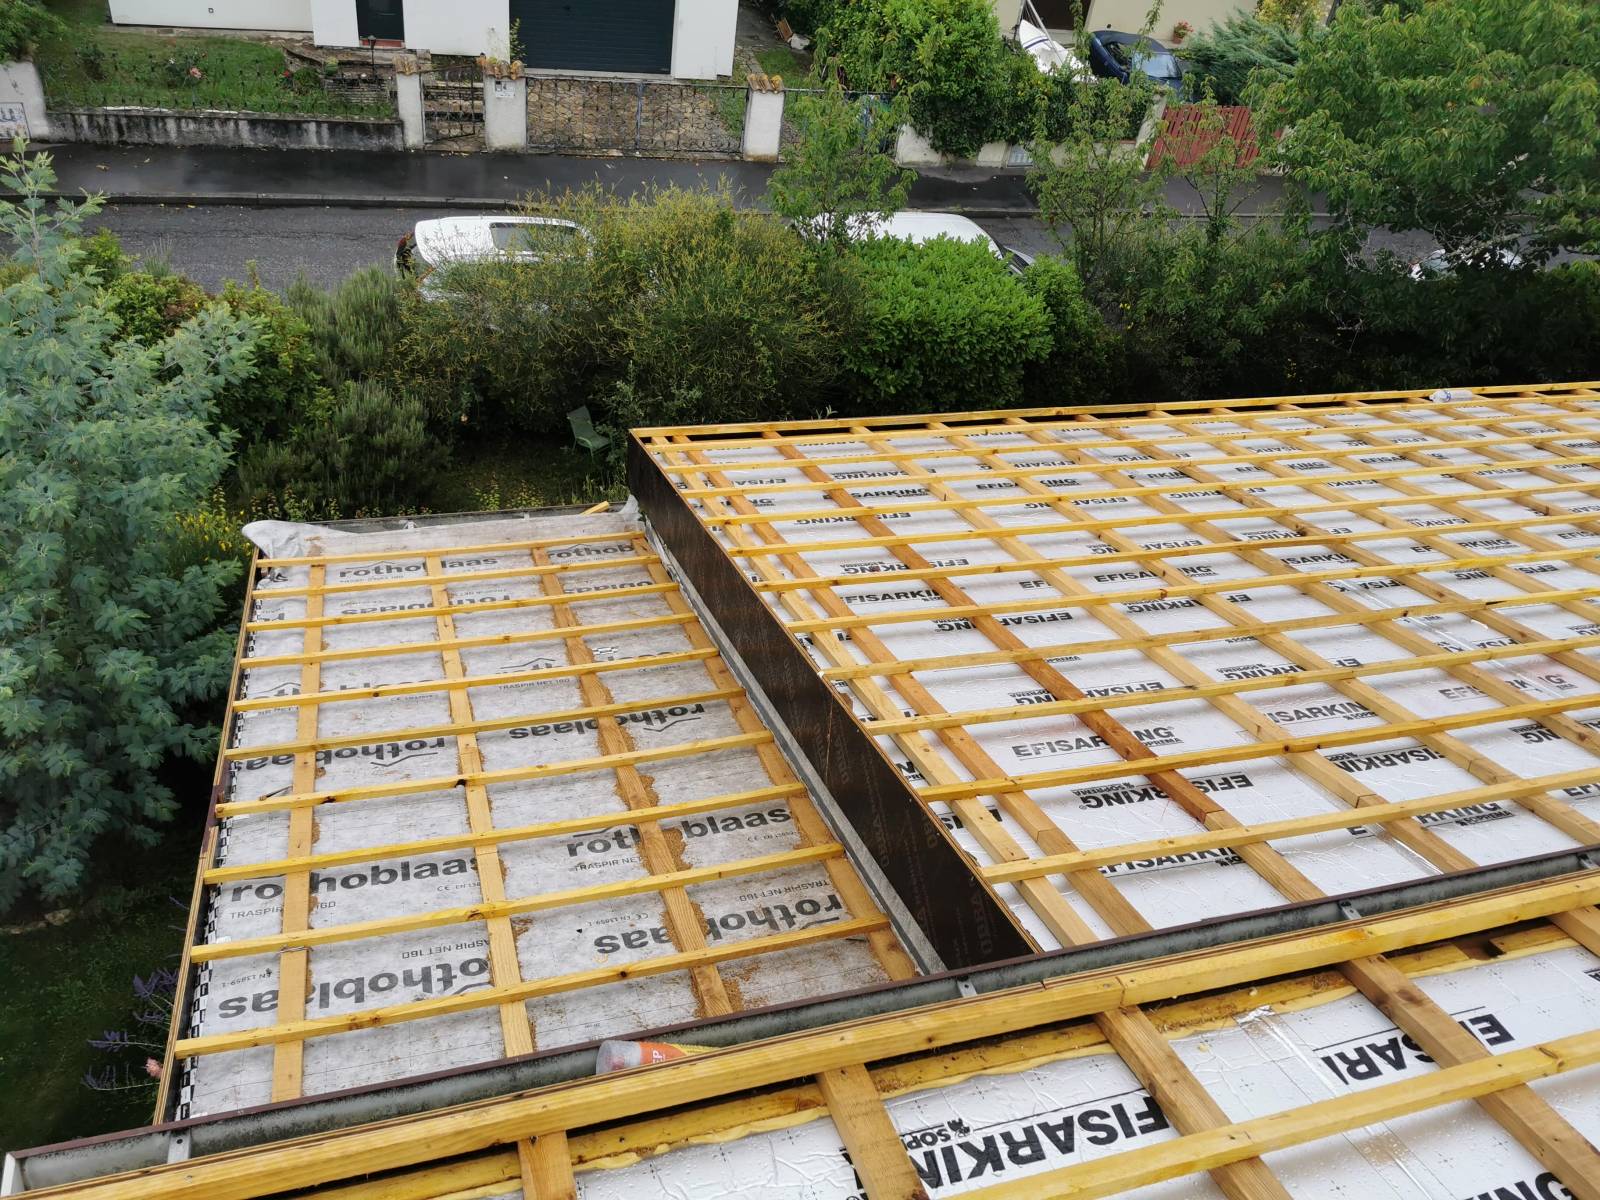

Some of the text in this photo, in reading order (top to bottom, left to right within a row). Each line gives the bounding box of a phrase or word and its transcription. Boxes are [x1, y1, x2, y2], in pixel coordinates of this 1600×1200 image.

[739, 891, 759, 903] 160
[761, 887, 782, 899] NET
[402, 949, 424, 960] 160
[426, 945, 452, 955] NET
